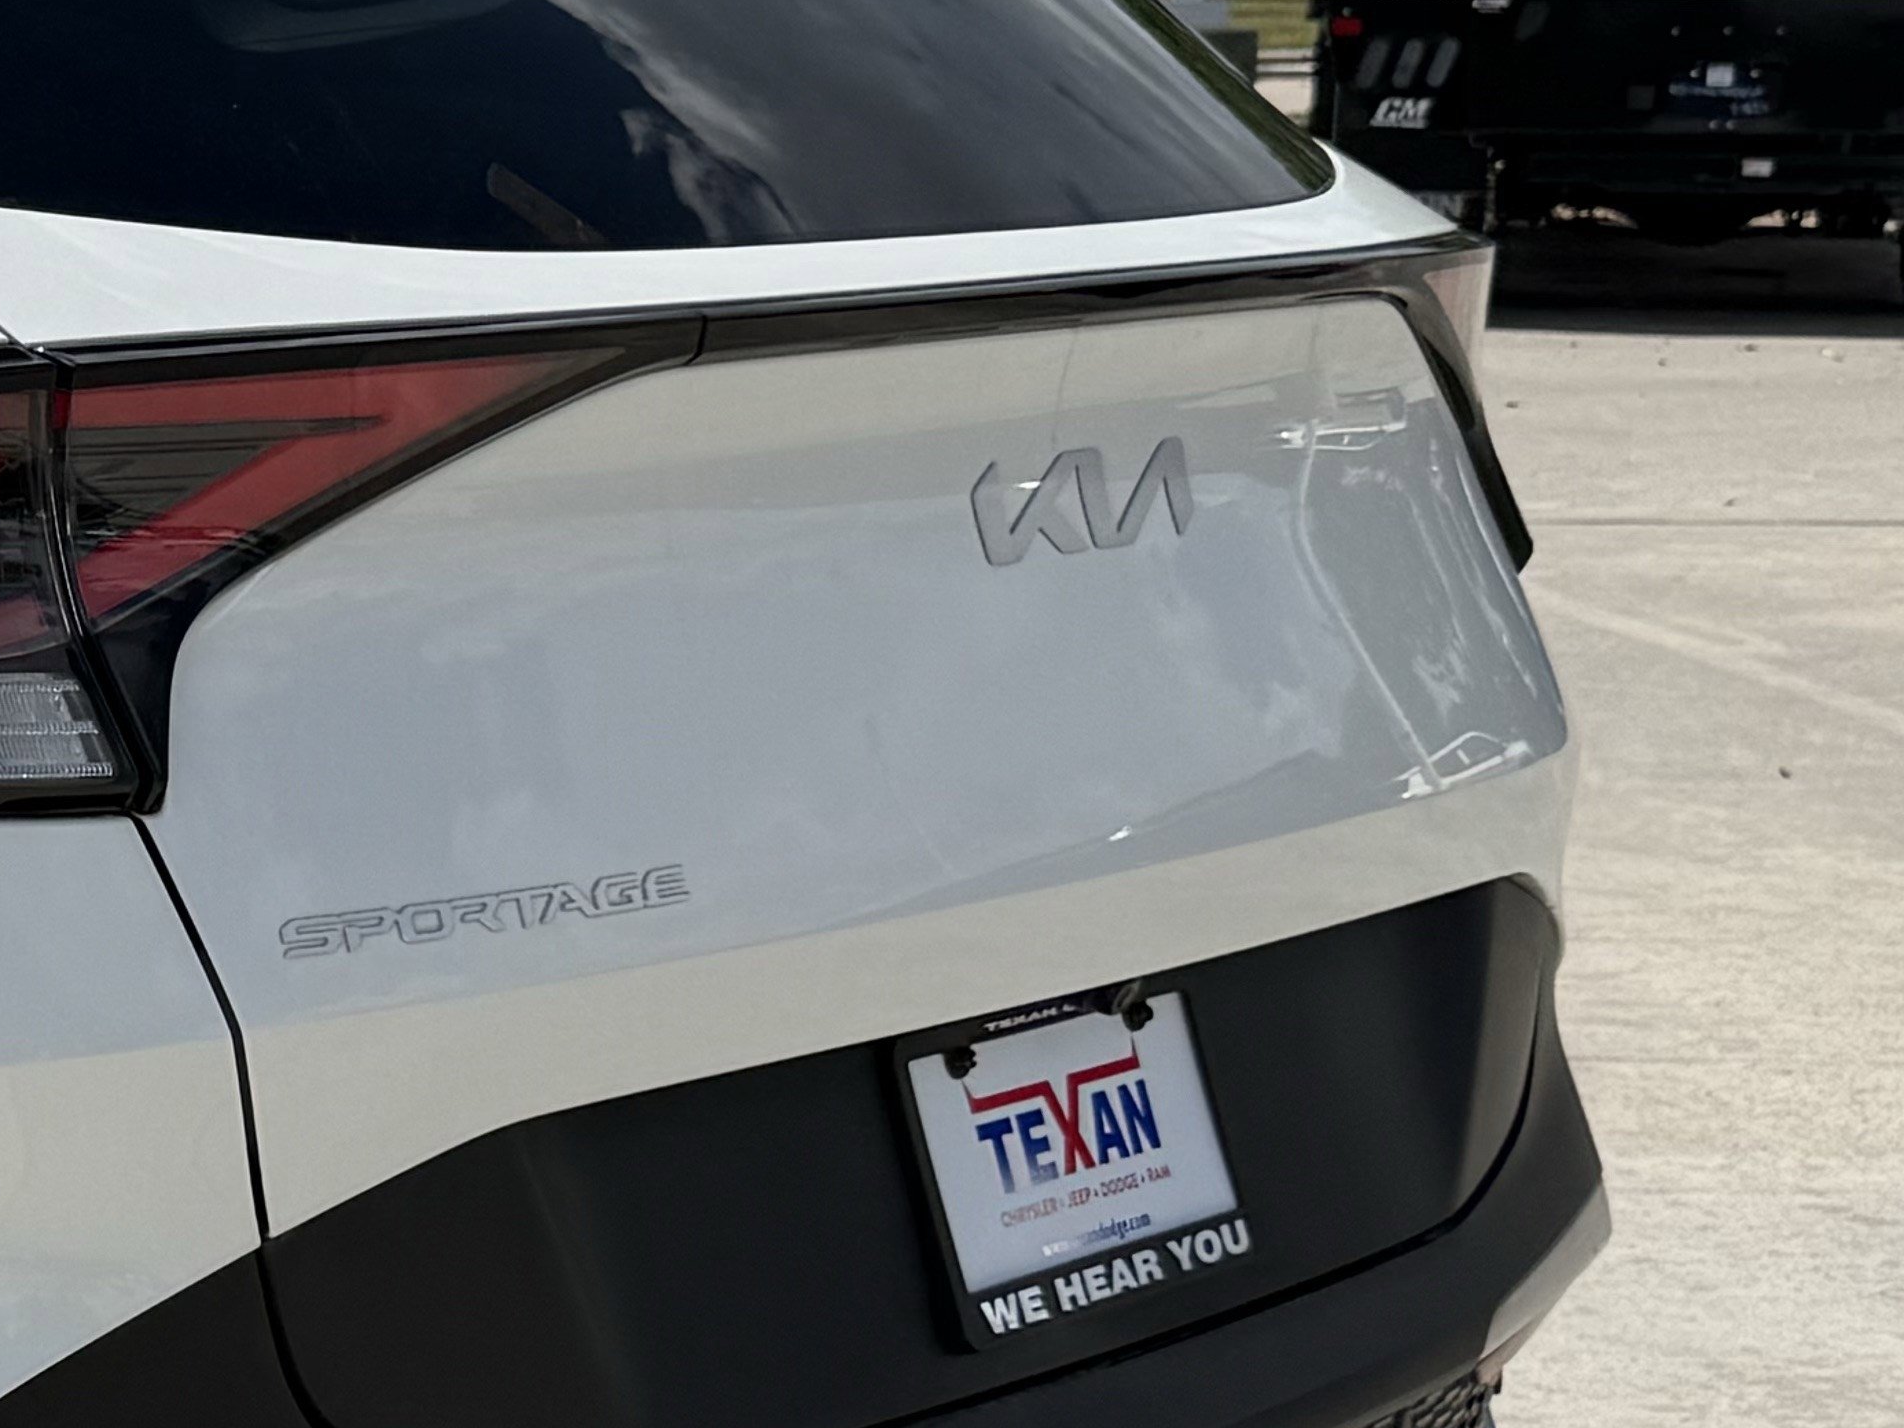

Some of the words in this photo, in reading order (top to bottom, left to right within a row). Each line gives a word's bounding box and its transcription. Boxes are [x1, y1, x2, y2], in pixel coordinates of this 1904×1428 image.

[970, 435, 1194, 567] KIA
[279, 863, 690, 959] SPORTAGE
[972, 1056, 1162, 1195] TEXAN
[1068, 1186, 1092, 1208] JEEP
[1100, 1172, 1139, 1198] DODGE
[1146, 1164, 1172, 1183] RAM
[980, 1284, 1051, 1335] WE
[1054, 1248, 1164, 1312] HEAR
[1166, 1218, 1252, 1272] YOU
